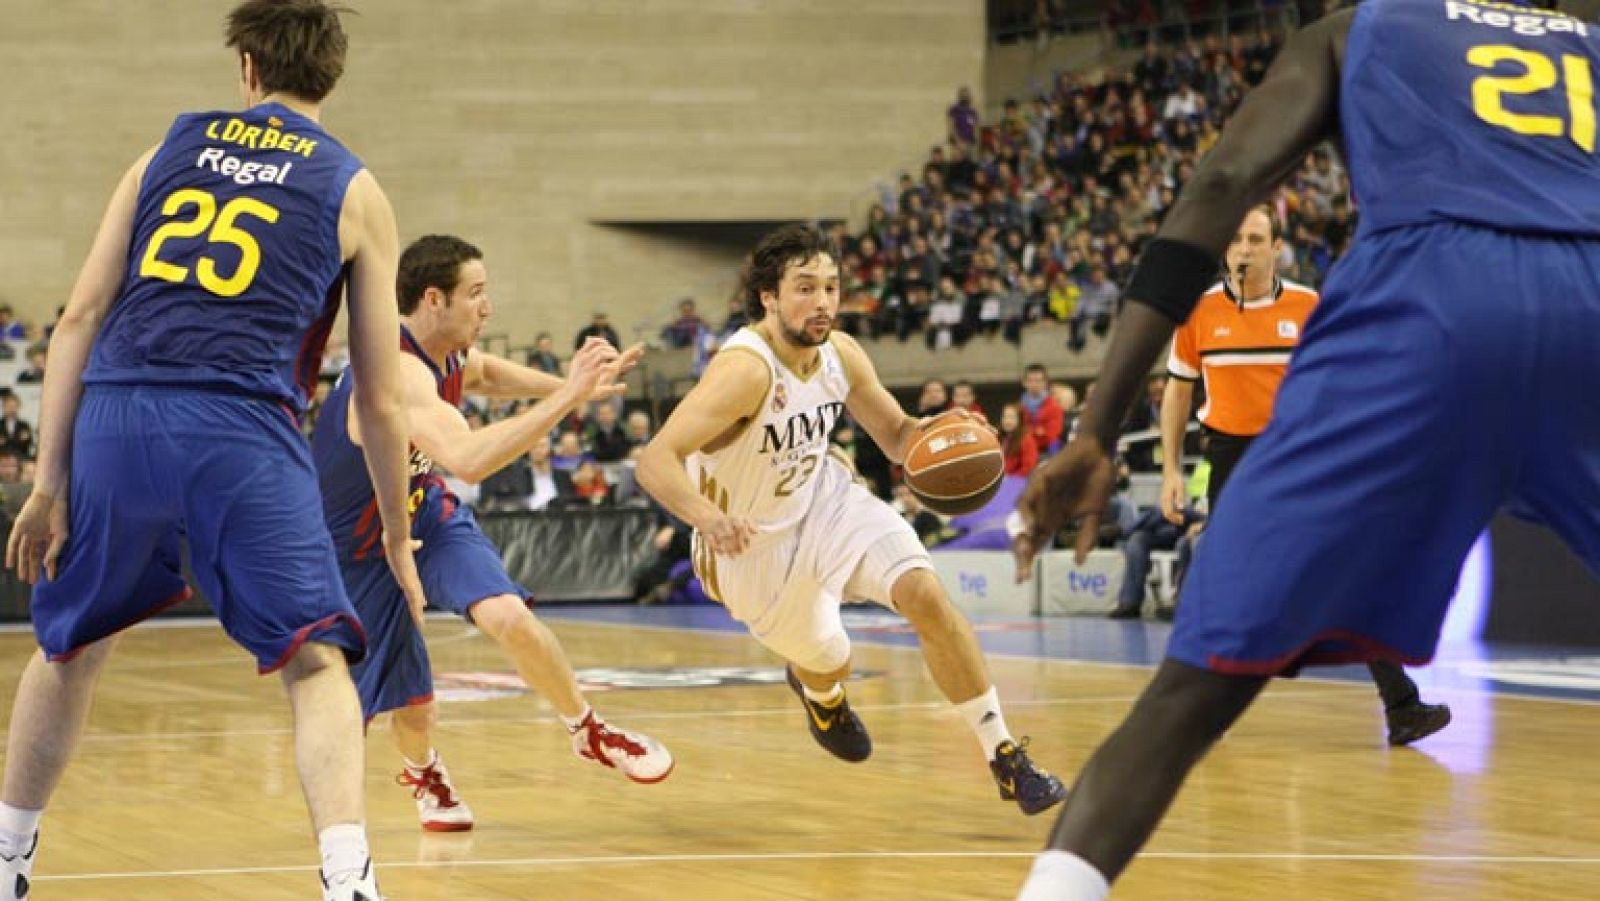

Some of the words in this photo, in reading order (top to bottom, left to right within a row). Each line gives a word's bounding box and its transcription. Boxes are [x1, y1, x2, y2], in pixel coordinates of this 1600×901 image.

[1466, 44, 1596, 154] 21
[197, 147, 292, 185] Regal
[139, 188, 280, 297] 25
[758, 401, 846, 453] MMT
[774, 454, 818, 497] 23
[1067, 569, 1108, 596] tve
